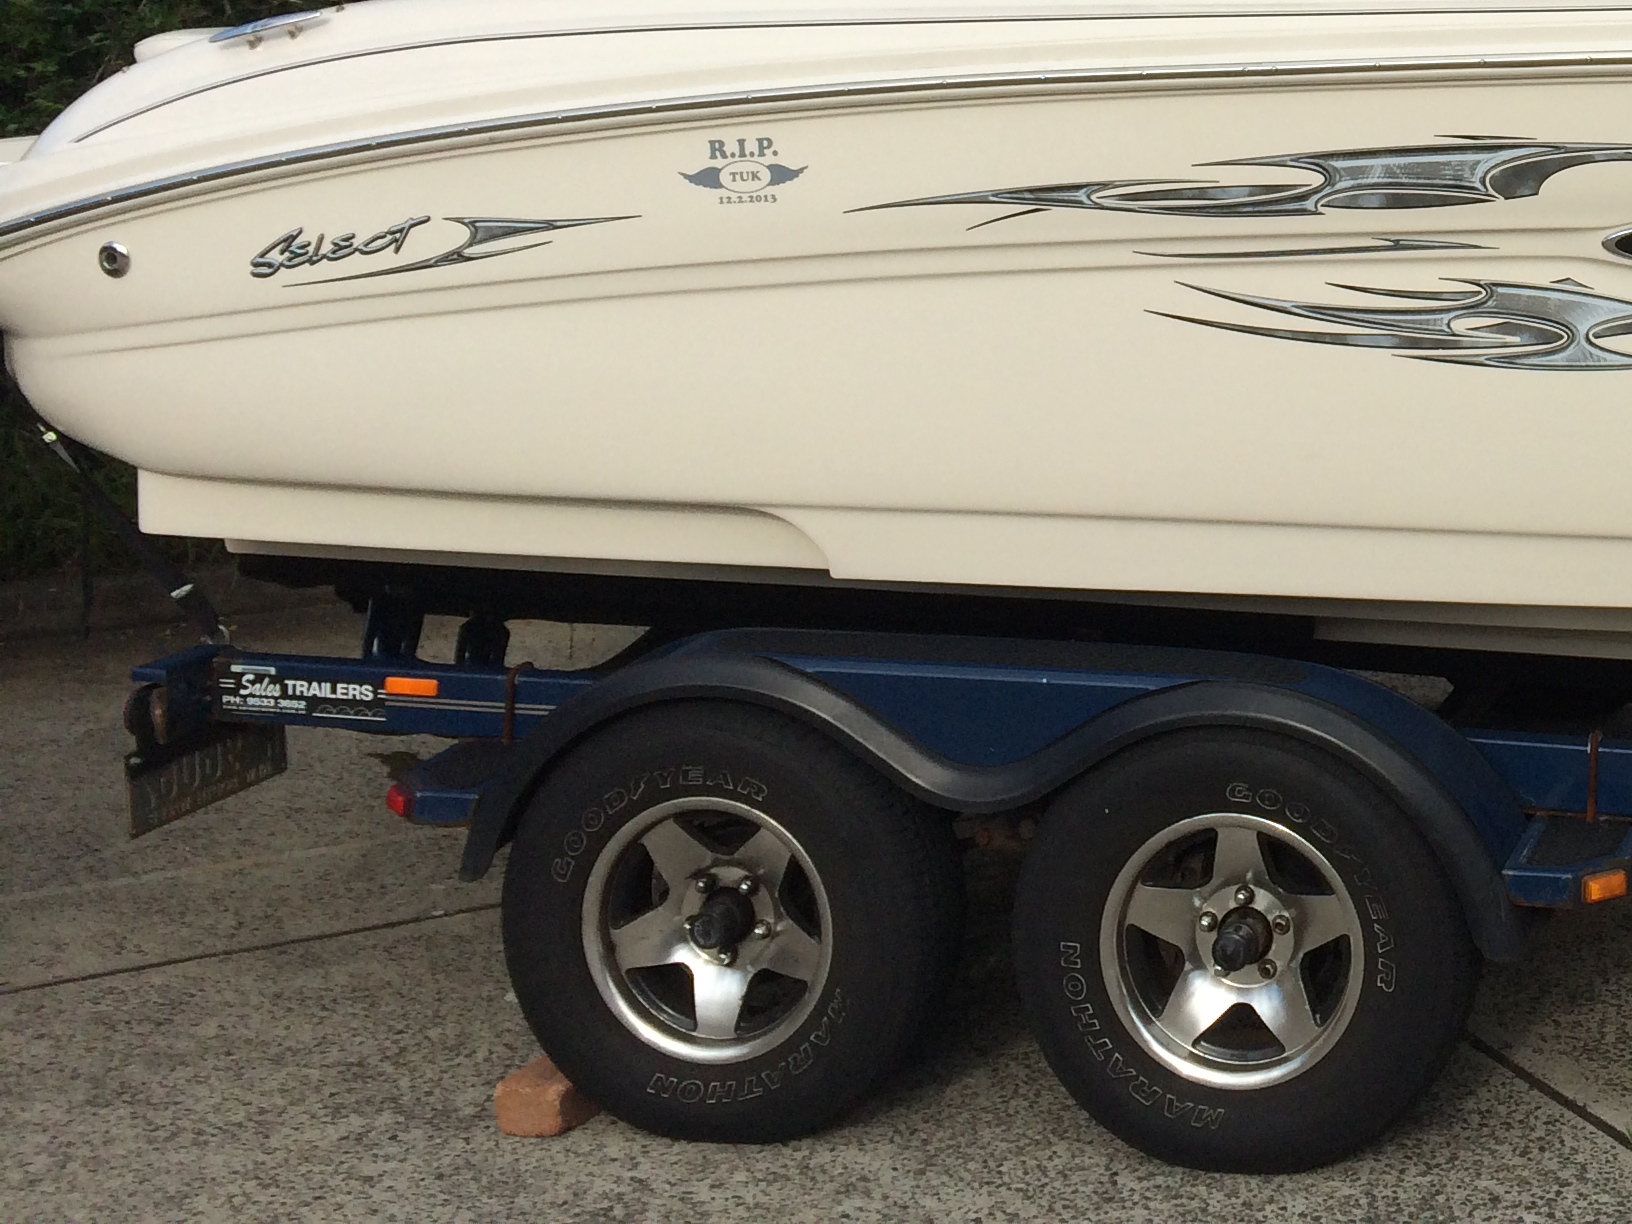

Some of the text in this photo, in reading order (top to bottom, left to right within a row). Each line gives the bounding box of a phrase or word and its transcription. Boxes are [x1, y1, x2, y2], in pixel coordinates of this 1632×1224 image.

[708, 137, 779, 160] R.I.P.
[729, 170, 762, 182] TUK
[718, 194, 778, 204] 12.2.2013
[239, 673, 374, 701] Sales TRAILERS
[646, 988, 850, 1103] MARATHON
[1060, 942, 1225, 1130] MARATHON
